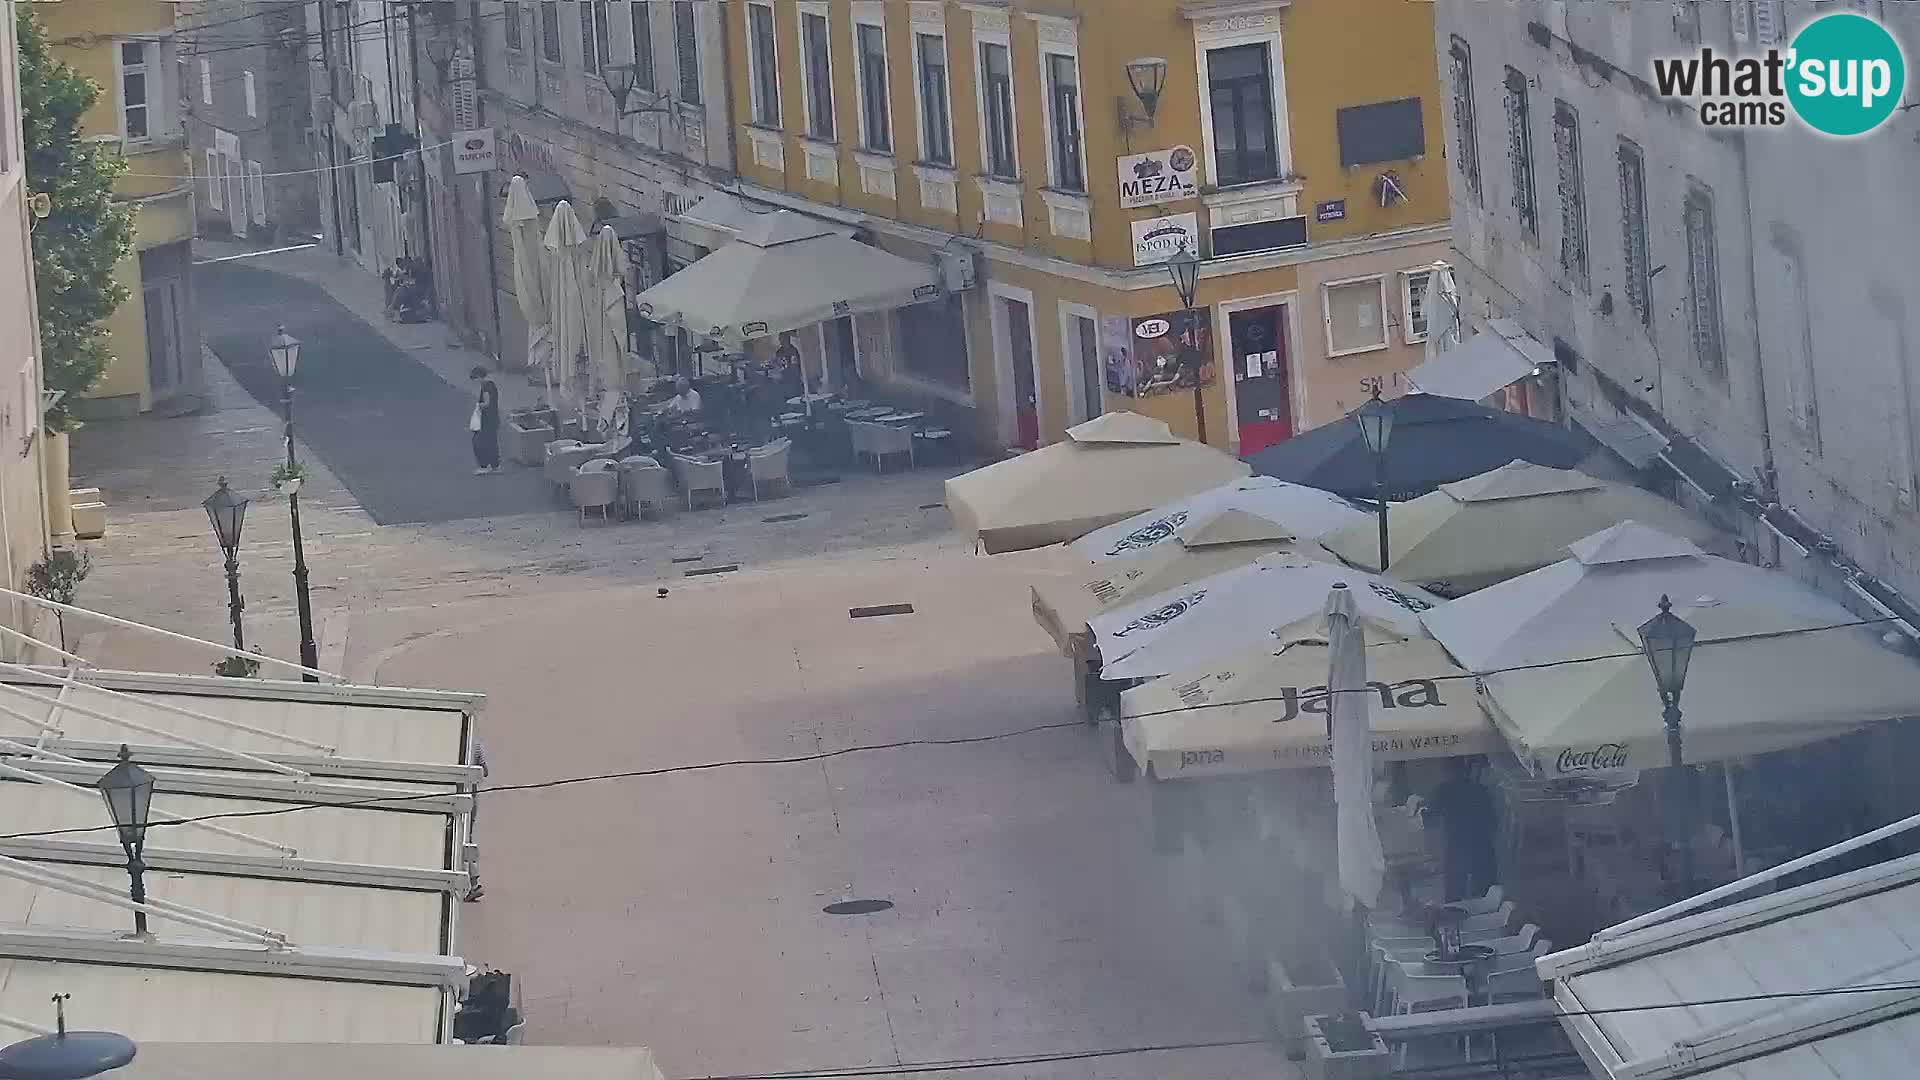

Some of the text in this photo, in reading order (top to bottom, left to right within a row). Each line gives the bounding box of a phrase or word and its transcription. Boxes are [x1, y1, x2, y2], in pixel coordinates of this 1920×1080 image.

[1122, 174, 1181, 198] MEZA
[1136, 239, 1171, 252] ISPOD
[1409, 733, 1461, 749] WATER
